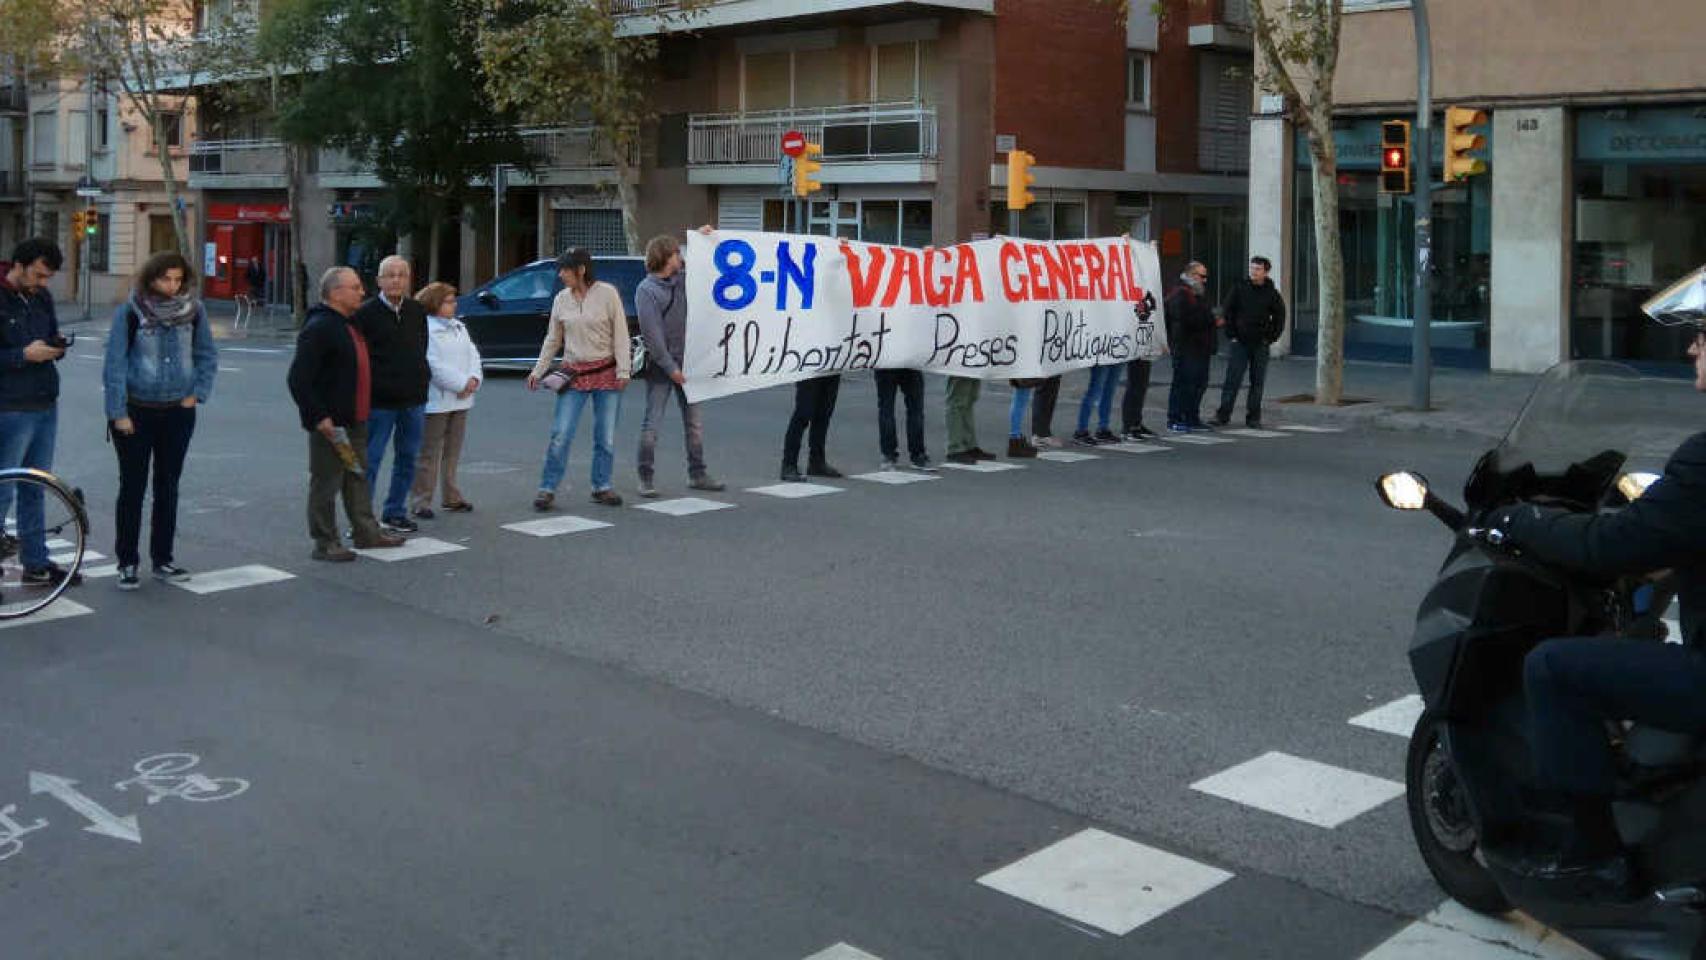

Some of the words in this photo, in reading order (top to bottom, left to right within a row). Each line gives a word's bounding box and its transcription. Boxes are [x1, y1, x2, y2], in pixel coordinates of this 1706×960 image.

[713, 239, 817, 311] 8-N
[839, 242, 985, 308] VAGA
[1000, 241, 1143, 303] GENERAL
[924, 312, 1019, 368] Preses
